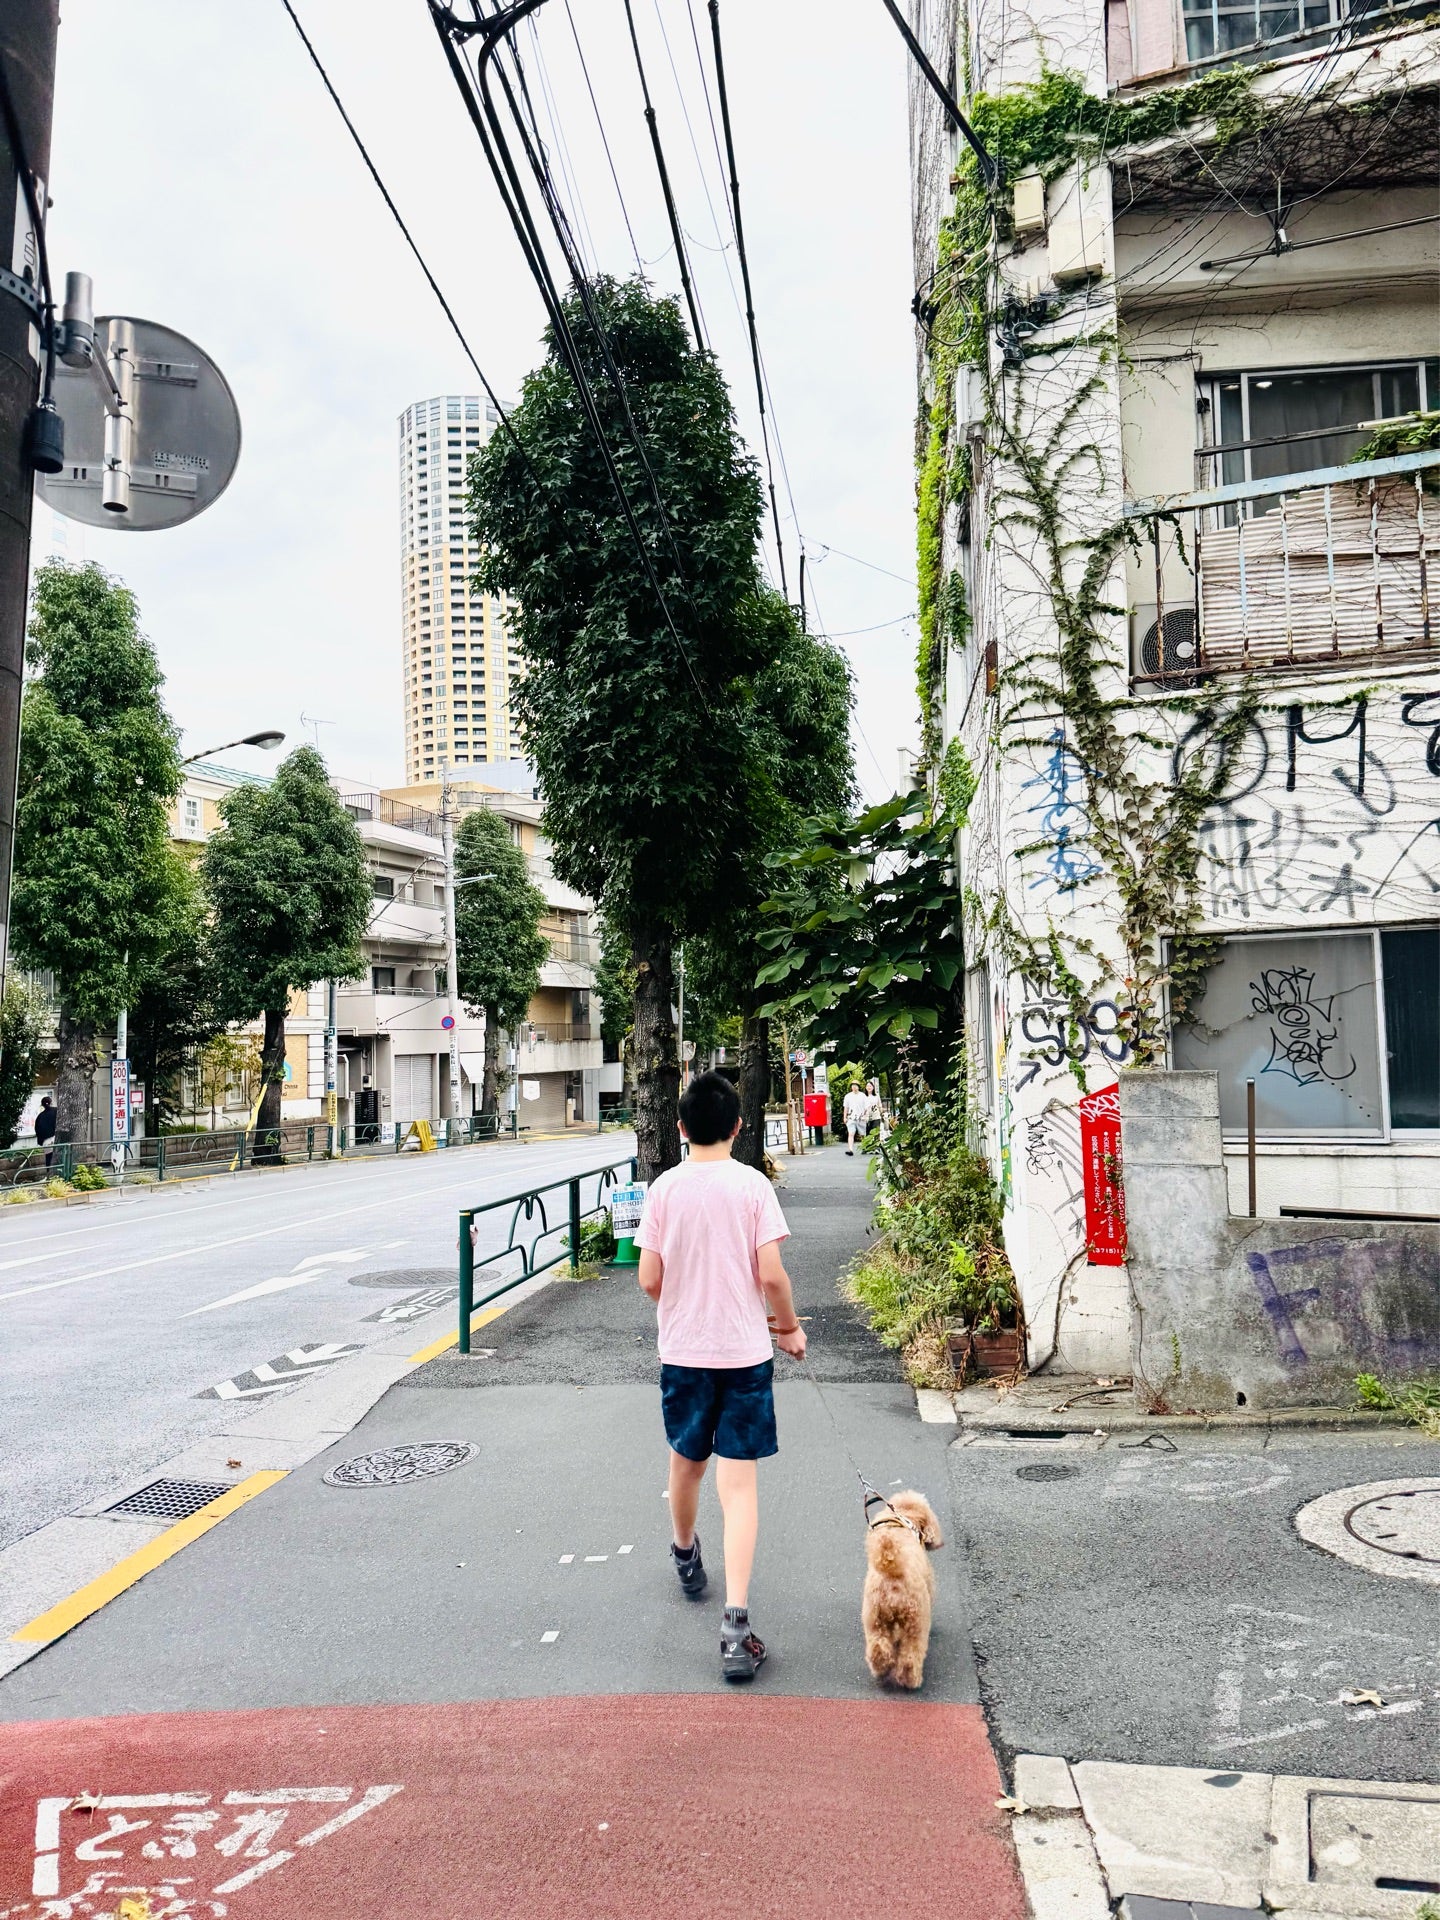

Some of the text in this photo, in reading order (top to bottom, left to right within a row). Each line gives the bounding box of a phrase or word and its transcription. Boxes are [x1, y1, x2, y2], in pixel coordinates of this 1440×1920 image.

[113, 1067, 127, 1079] 200
[114, 1086, 126, 1131] 山手通り
[74, 1808, 291, 1860] とまれ
